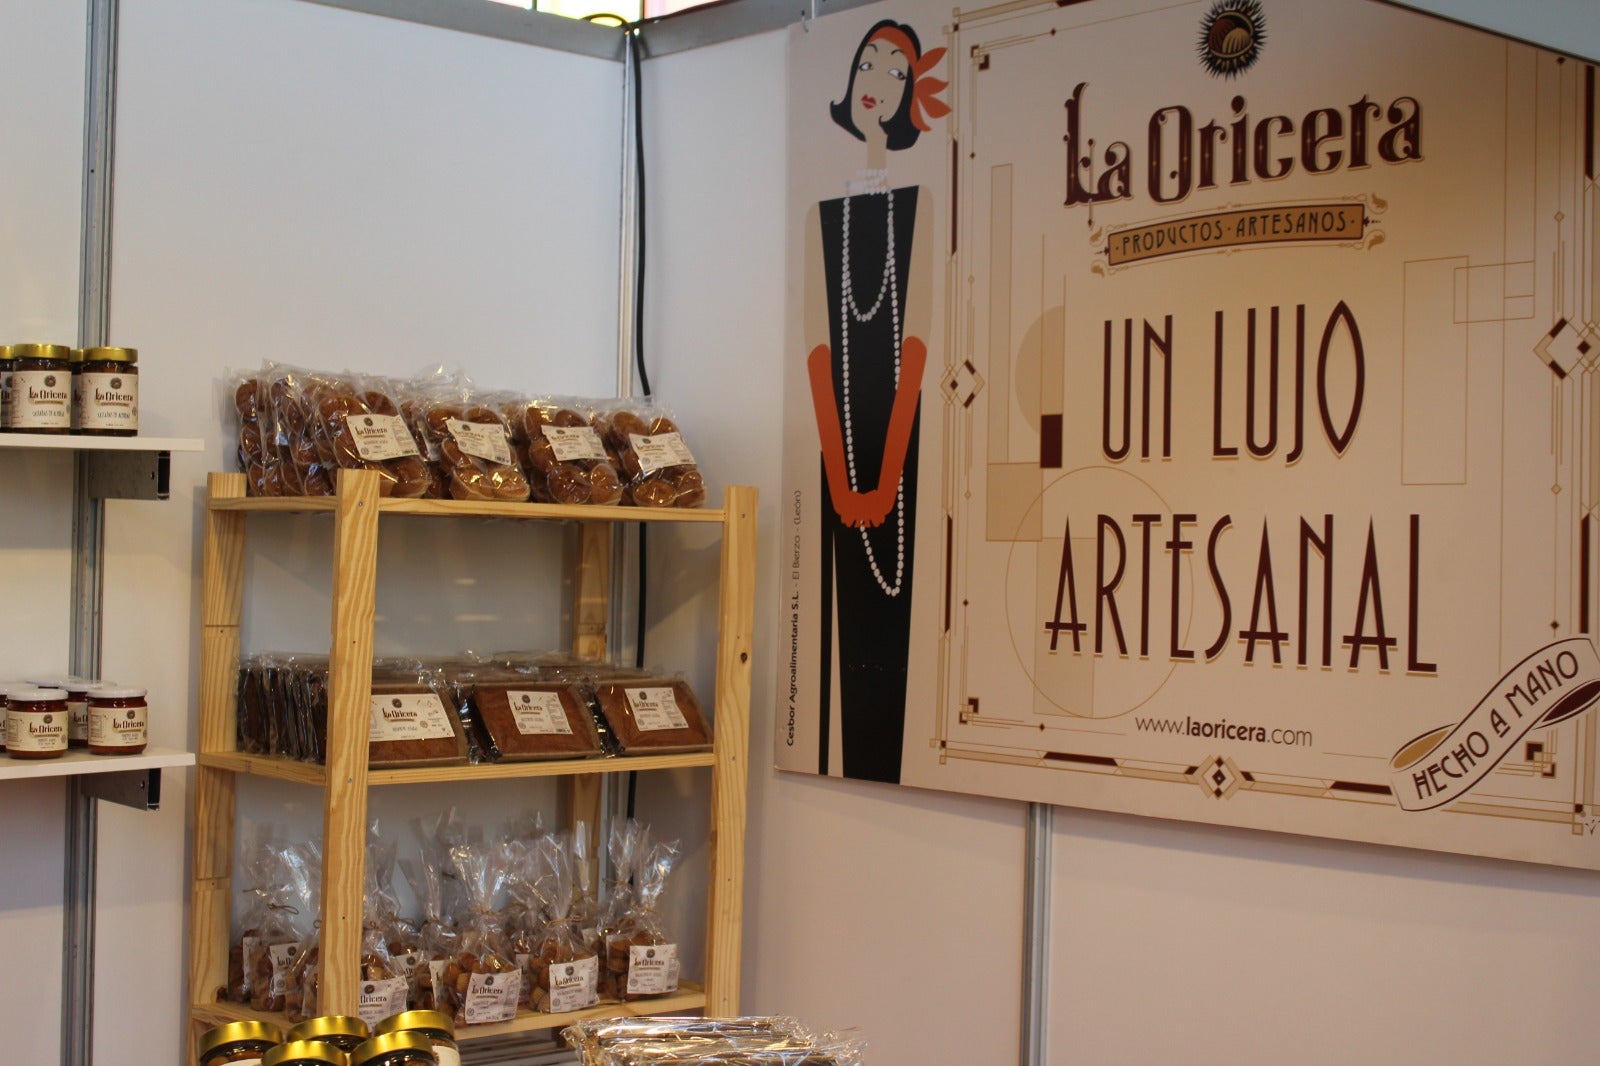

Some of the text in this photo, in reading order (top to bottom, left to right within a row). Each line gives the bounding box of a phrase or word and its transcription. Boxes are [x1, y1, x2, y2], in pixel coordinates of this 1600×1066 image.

[1064, 82, 1424, 207] La Oricera
[1122, 210, 1347, 257] PRODUCTOS ARTESANOS
[1102, 300, 1366, 466] UN LUJO
[787, 489, 802, 747] Cesbor Agroalimentaria S.L. El Bierzo (León)
[1044, 514, 1438, 674] ARTESANAL
[1135, 716, 1313, 747] www.laoricera.com
[1412, 650, 1578, 800] HECHO A MANO
